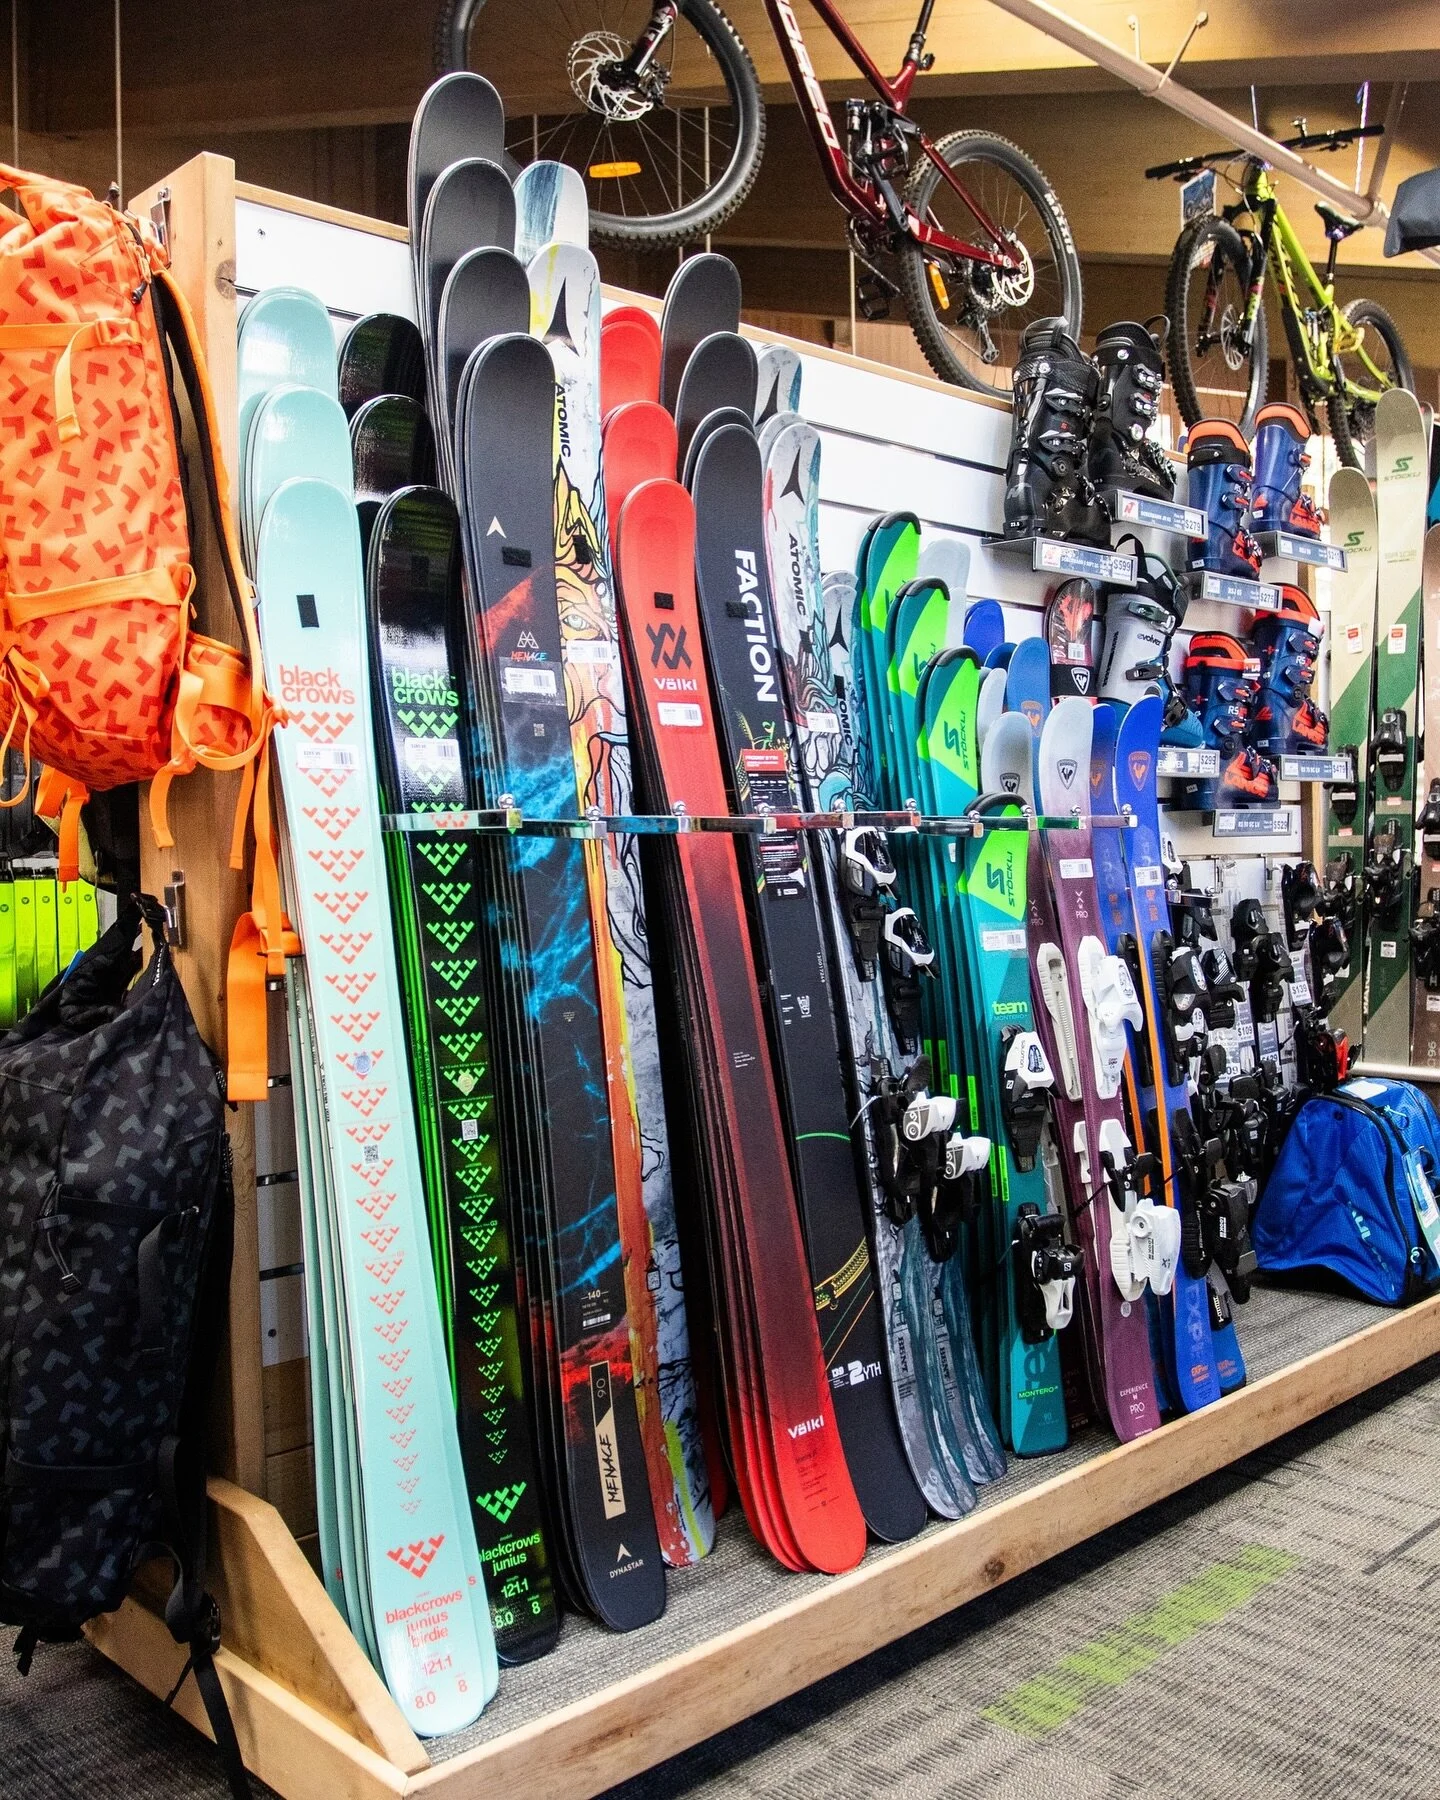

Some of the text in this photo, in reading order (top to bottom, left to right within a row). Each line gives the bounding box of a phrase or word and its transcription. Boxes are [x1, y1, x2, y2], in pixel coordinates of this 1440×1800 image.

[776, 0, 840, 150] ORCO
[555, 382, 571, 458] ATOMIC
[789, 533, 806, 616] ATOMIC
[1113, 559, 1131, 572] $599
[735, 550, 778, 702] FACTION
[510, 651, 548, 662] MENACE
[279, 664, 342, 688] black
[391, 666, 446, 690] black
[654, 677, 698, 691] Völkl
[282, 686, 356, 705] crows
[393, 687, 460, 706] crows
[840, 699, 854, 746] OMIC
[1076, 910, 1088, 919] PRO
[992, 1001, 1028, 1015] team
[588, 1290, 601, 1300] 140
[596, 1378, 606, 1398] 90
[1120, 1383, 1148, 1397] EXPERIENCE
[1129, 1402, 1145, 1415] PRO
[787, 1415, 825, 1439] Völkl
[599, 1434, 622, 1503] MENACE
[492, 1553, 527, 1576] junius
[609, 1559, 644, 1579] DYNASTAR
[501, 1578, 529, 1598] 121.1
[385, 1590, 463, 1624] blackcrows
[532, 1601, 541, 1614] 8
[406, 1611, 449, 1637] junius
[494, 1611, 514, 1629] 8.0
[411, 1626, 449, 1648] birdie
[422, 1656, 452, 1676] 121.1
[458, 1680, 468, 1693] 8
[414, 1691, 436, 1710] 8.0
